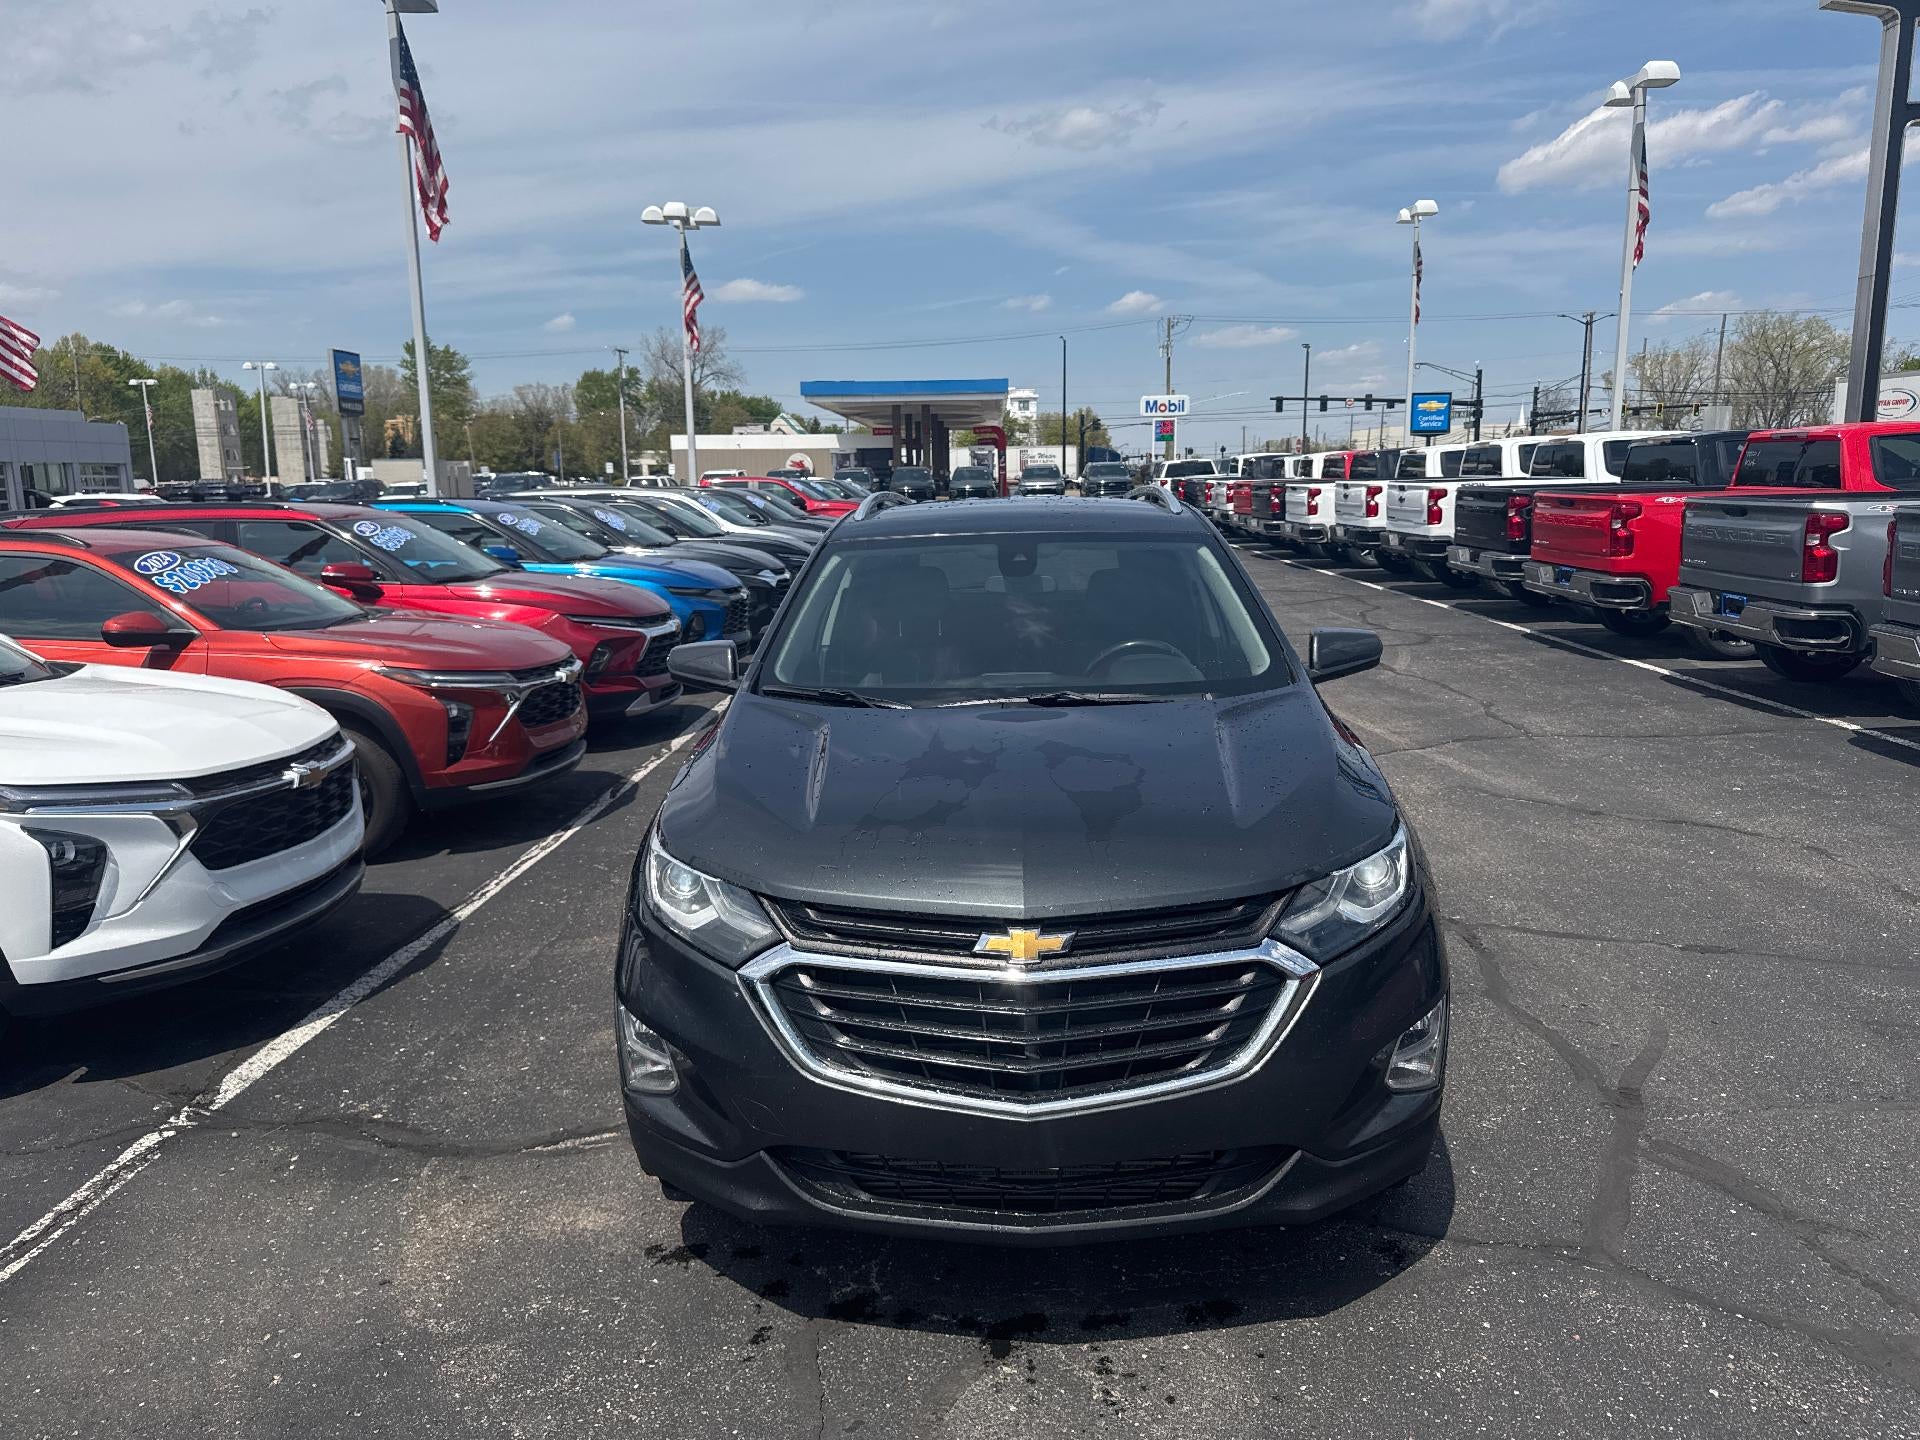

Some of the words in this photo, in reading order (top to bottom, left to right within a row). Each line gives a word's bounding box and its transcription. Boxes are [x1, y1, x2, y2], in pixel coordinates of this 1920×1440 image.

[1145, 399, 1185, 413] Mobil
[1686, 524, 1792, 545] CHEVROLET
[140, 552, 173, 572] 2024
